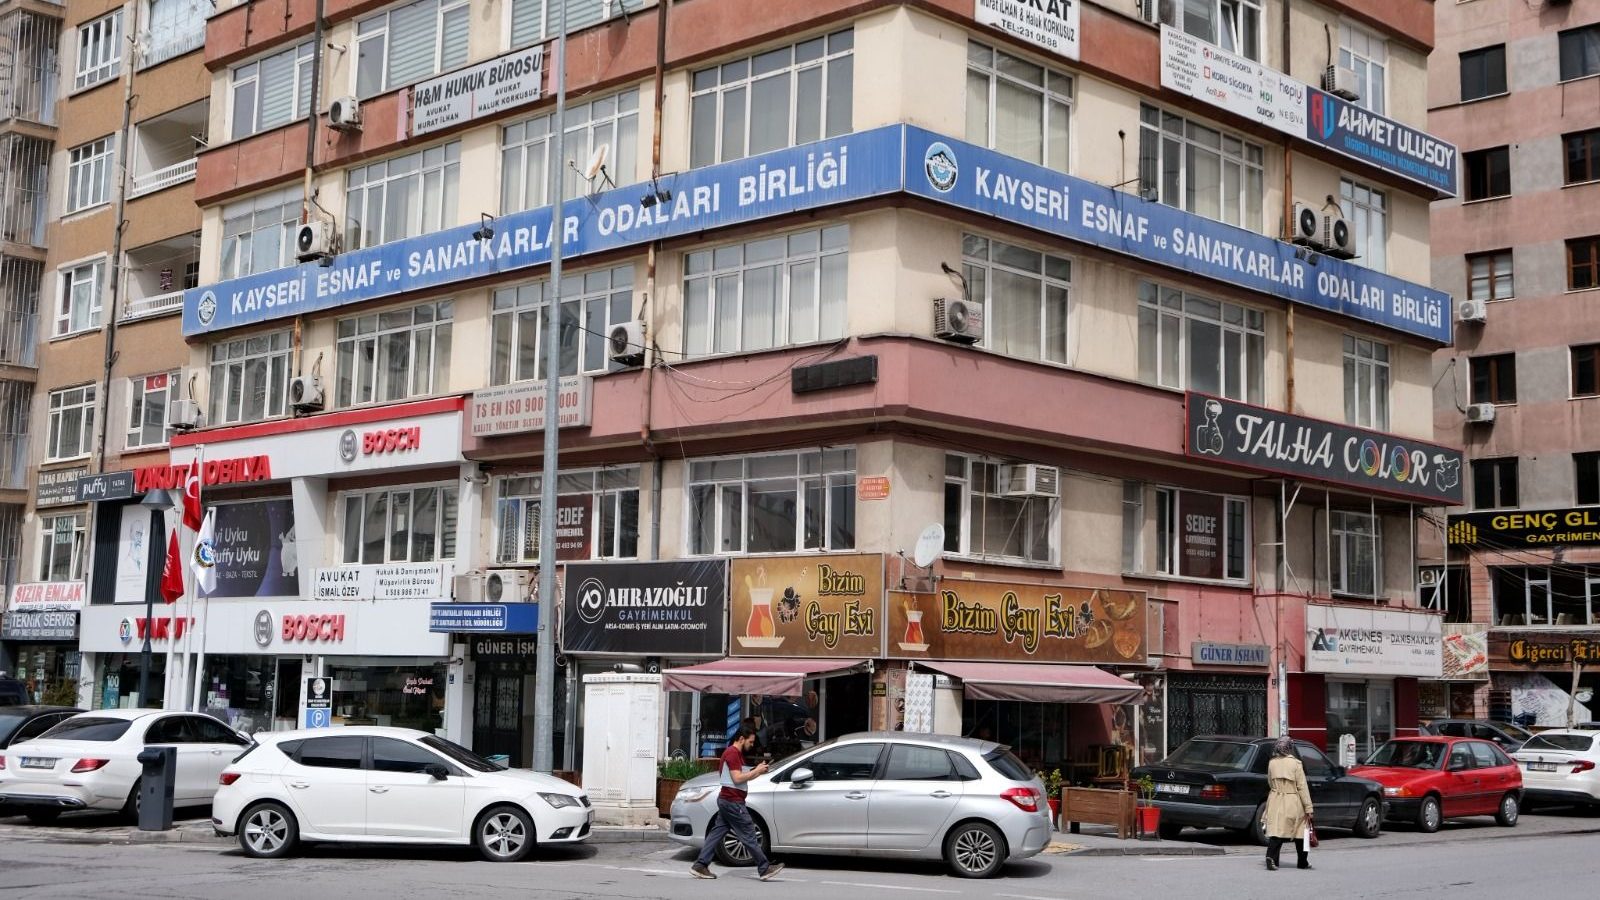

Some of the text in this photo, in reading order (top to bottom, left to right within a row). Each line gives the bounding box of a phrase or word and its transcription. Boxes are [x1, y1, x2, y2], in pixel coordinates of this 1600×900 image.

[415, 53, 542, 109] H&M HUKUK BÜROSU
[495, 82, 521, 96] AVUKAT
[501, 88, 538, 105] KORKUSUZ
[426, 104, 451, 117] AVUKAT
[1338, 106, 1454, 170] AHMET ULUSOY
[231, 269, 306, 314] KAYSERİ
[317, 261, 382, 298] ESNAF
[386, 268, 401, 282] ve
[408, 216, 579, 277] SANATKARLAR
[598, 183, 720, 236] ODALARI
[739, 146, 847, 207] BİRLİĞİ
[975, 166, 1069, 221] KAYSERİ
[1082, 200, 1149, 243] ESNAF
[1153, 234, 1167, 250] ve
[1173, 227, 1304, 289] SANATKARLAR
[1318, 272, 1385, 313] ODALARI
[1393, 290, 1442, 329] BİRLİĞİ
[476, 403, 487, 418] TS
[491, 401, 502, 416] EN
[505, 398, 521, 415] ISO
[362, 427, 420, 455] BOSCH
[1236, 414, 1430, 486] TALHA COLOR
[83, 478, 107, 499] puffy
[556, 506, 584, 526] EDEF
[1185, 514, 1217, 534] SEDEF
[1492, 511, 1600, 530] GENÇ GL
[225, 526, 248, 546] Uyku
[236, 547, 260, 566] Uyku
[320, 570, 360, 583] AVUKAT
[818, 564, 865, 596] Bizim
[44, 584, 84, 602] EMLAK
[318, 583, 360, 597] İSMAİL ÖZEV
[605, 581, 708, 607] AHRAZOĞLU
[43, 612, 76, 628] SERVİS
[619, 608, 692, 621] GAYRİMENKUL
[805, 600, 874, 649] Çay Evi
[941, 590, 1076, 654] Bizim Çay Evi
[281, 614, 345, 641] BOSCH
[477, 639, 514, 654] GÜNER
[1200, 644, 1264, 664] GÜNER İŞHANI
[1511, 640, 1564, 662] Ciğerci
